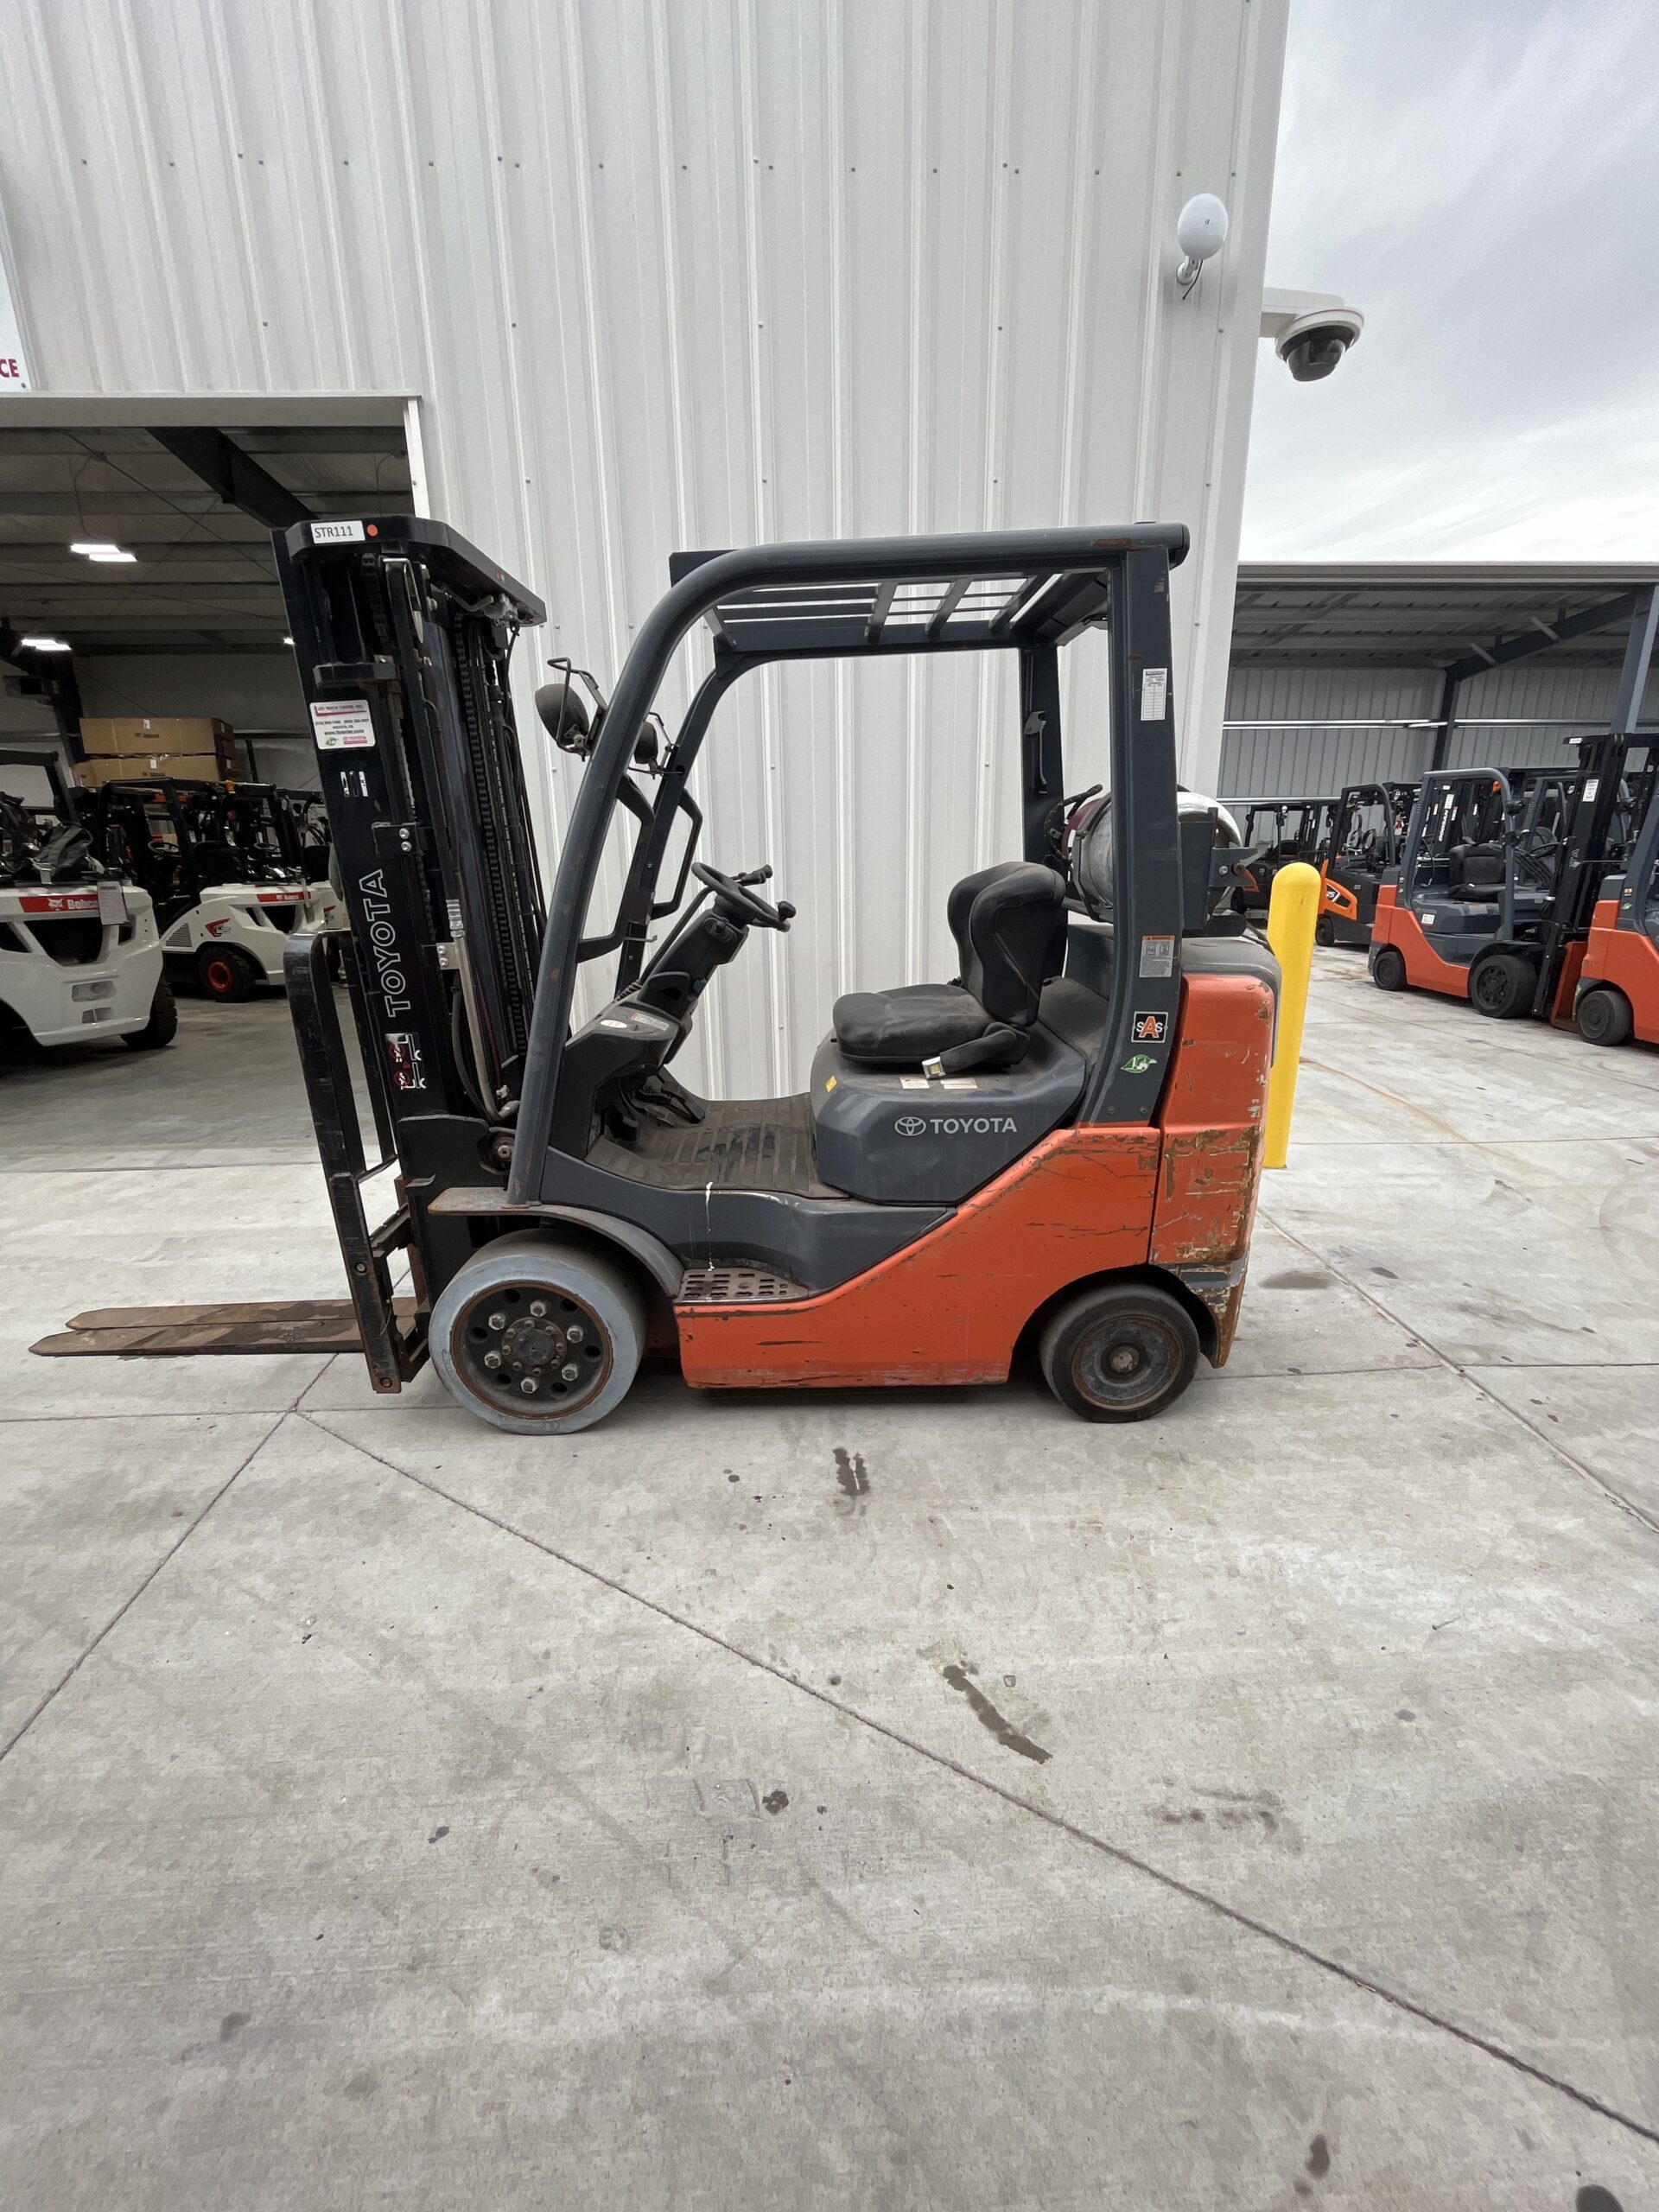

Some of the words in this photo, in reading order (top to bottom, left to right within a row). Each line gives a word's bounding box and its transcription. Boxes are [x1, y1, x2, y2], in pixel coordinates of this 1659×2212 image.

[314, 525, 354, 538] STR111
[1438, 809, 1449, 842] DOOSAN
[67, 899, 99, 910] Bobca
[359, 868, 411, 1018] TOYOTA
[1135, 1015, 1164, 1039] SAS
[929, 1117, 1018, 1134] TOYOTA
